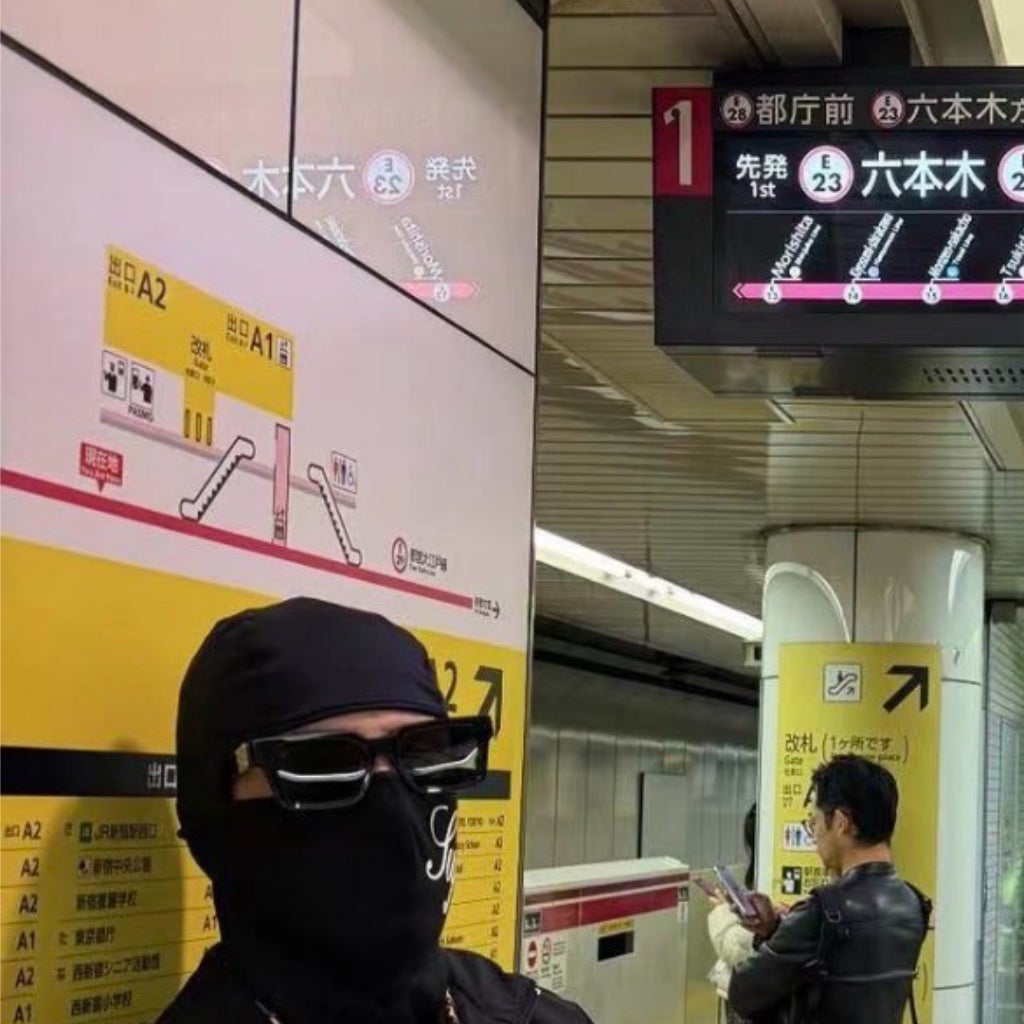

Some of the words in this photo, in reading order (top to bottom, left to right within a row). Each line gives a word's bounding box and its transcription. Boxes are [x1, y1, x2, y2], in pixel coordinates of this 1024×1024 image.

[727, 106, 747, 122] 28
[756, 93, 855, 126] 都庁前
[879, 107, 898, 120] 23
[663, 100, 693, 186] 1
[736, 154, 788, 180] 先発
[821, 155, 831, 169] E
[812, 173, 842, 192] 23
[861, 150, 986, 198] 六本木
[750, 181, 776, 198] 1st
[770, 215, 814, 279] Morishita
[109, 254, 136, 283] 出口
[137, 270, 167, 310] A2
[226, 313, 250, 339] 出口
[250, 325, 274, 361] A1
[784, 732, 818, 754] 改札
[148, 761, 177, 788] 出口
[23, 821, 42, 840] A2
[21, 858, 40, 877] A2
[19, 894, 38, 914] A2
[17, 930, 36, 951] A1
[15, 967, 35, 988] A2
[13, 1003, 33, 1024] A1
